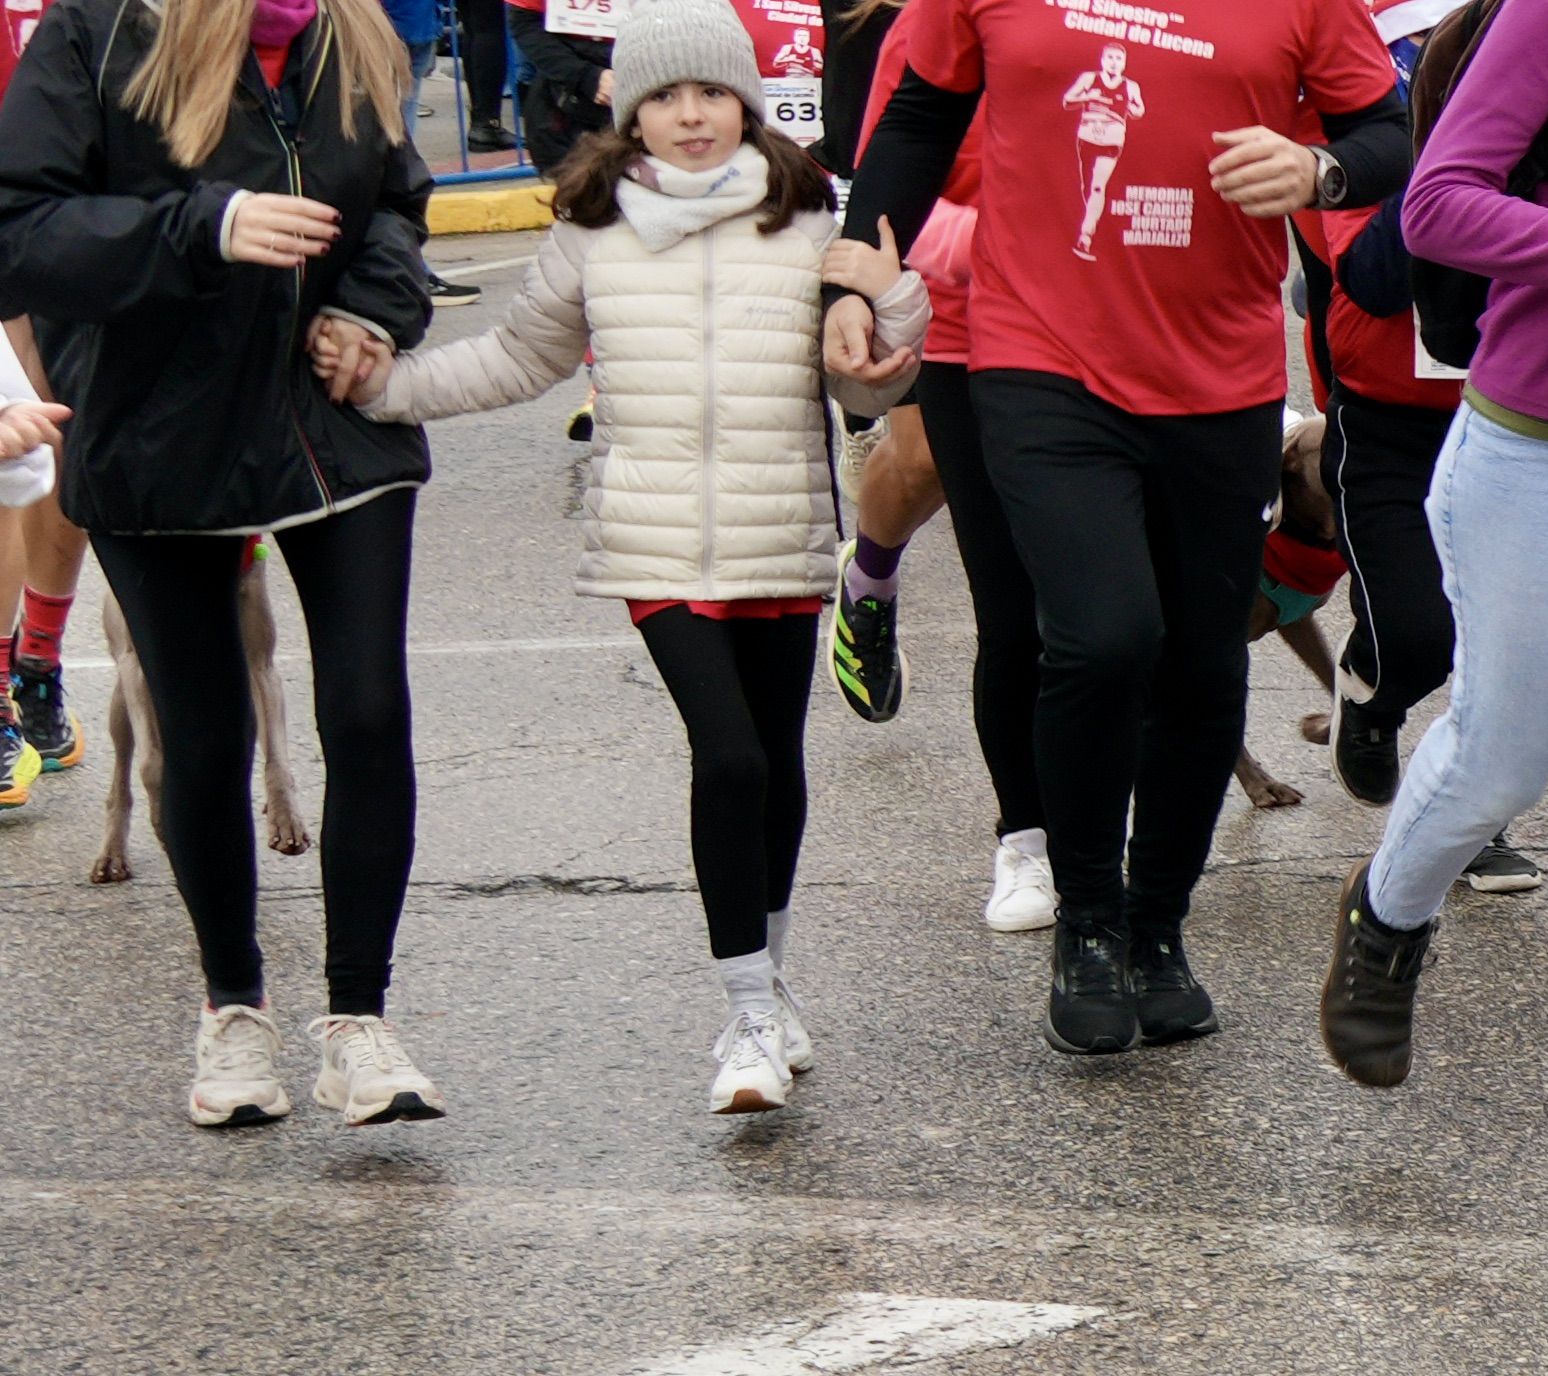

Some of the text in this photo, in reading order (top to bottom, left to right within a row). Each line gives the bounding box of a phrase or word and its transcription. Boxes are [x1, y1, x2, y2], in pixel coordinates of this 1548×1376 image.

[1065, 11, 1214, 59] Ciudad de Lucena
[776, 103, 823, 121] 63
[1126, 185, 1193, 201] MEMORIAL
[1143, 201, 1193, 216] CARLOS
[1131, 216, 1192, 230] HURTADO
